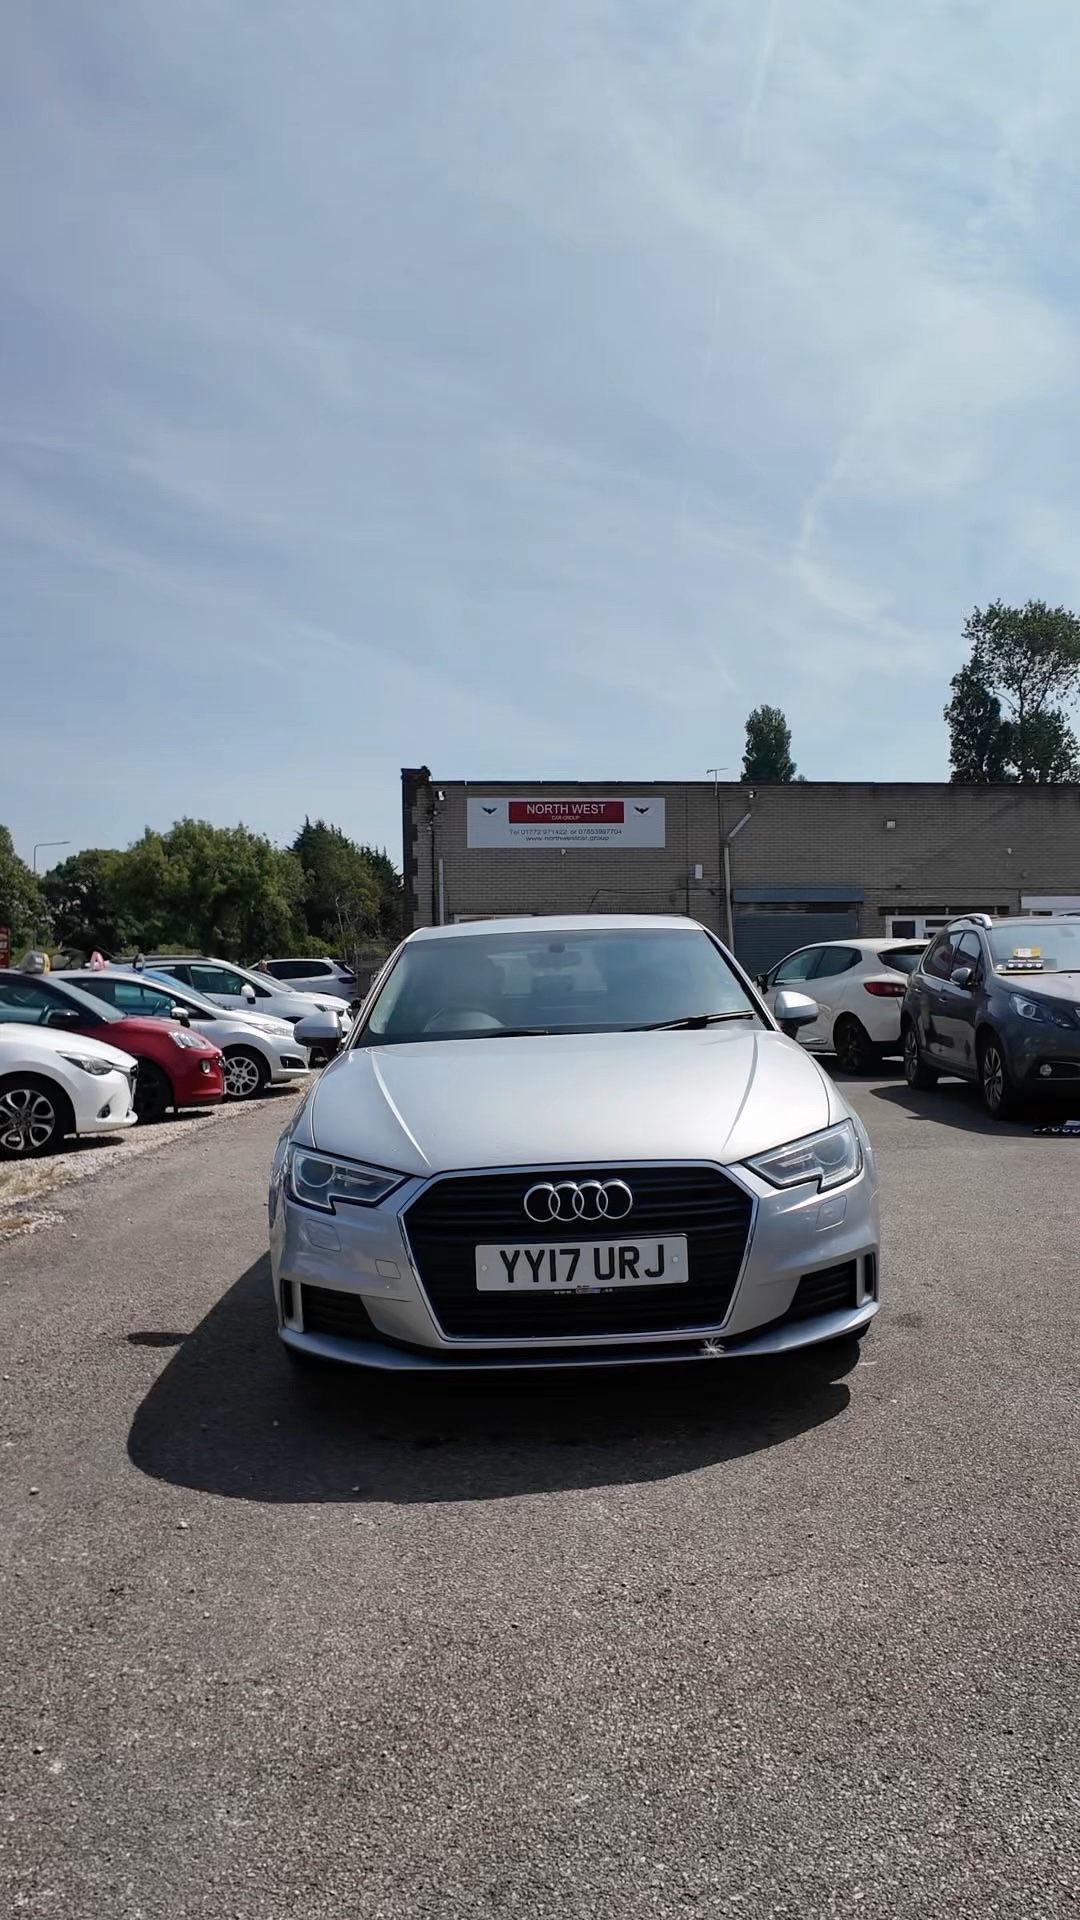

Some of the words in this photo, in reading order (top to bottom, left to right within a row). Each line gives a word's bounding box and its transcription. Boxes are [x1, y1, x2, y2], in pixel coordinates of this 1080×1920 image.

[526, 803, 569, 815] NORTH
[572, 803, 606, 815] WEST
[500, 1248, 581, 1283] YY17
[593, 1244, 665, 1280] URJ
